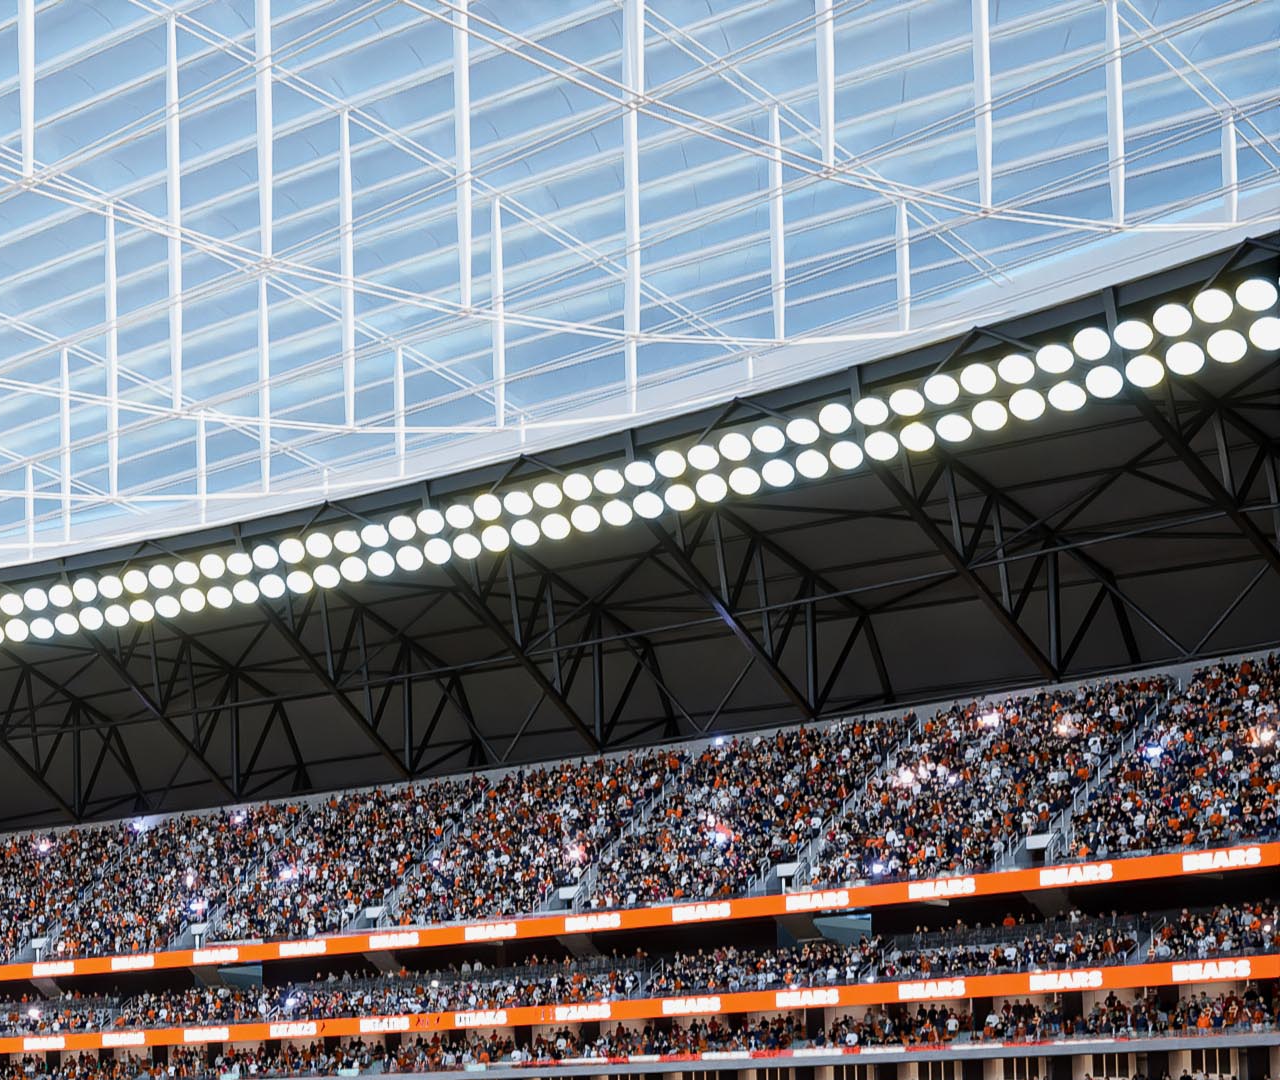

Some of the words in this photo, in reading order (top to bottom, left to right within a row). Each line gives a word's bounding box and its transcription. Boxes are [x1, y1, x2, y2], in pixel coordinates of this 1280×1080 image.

[1182, 847, 1261, 872] BEARS
[1040, 863, 1113, 886] BEARS
[908, 877, 976, 899] BEARS
[786, 890, 849, 912] BEARS
[1029, 969, 1103, 991] BEARS
[1172, 960, 1251, 982] BEARS
[776, 986, 839, 1008] BEARS
[898, 979, 965, 1000] BEARS
